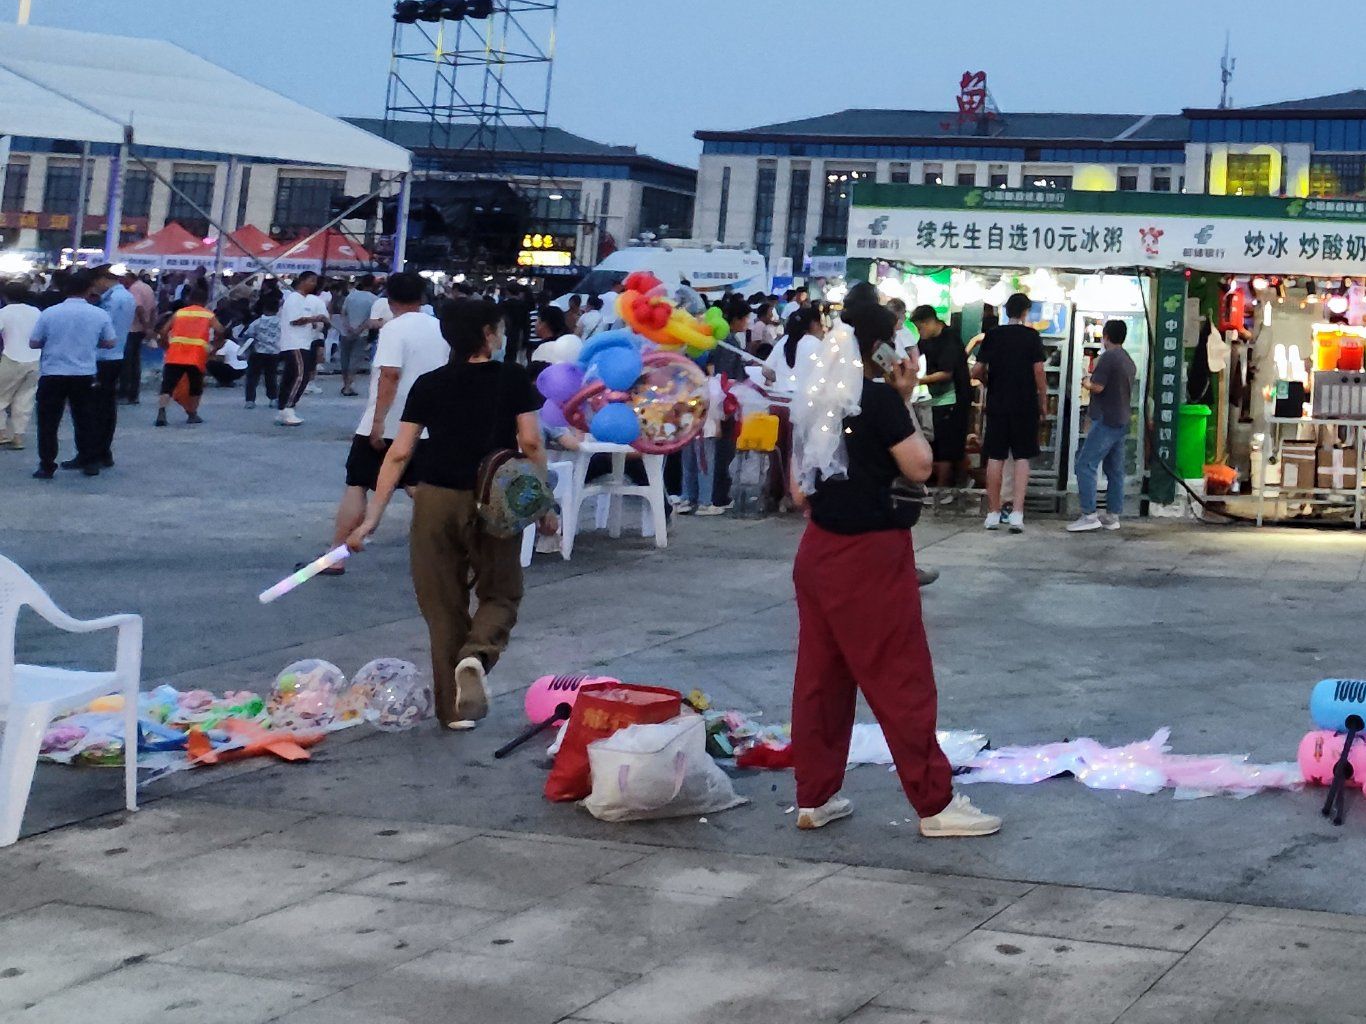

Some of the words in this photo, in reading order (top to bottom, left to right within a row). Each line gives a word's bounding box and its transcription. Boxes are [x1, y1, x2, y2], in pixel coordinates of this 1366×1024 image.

[1243, 230, 1288, 258] 炒冰
[1299, 232, 1366, 262] 炒酸奶
